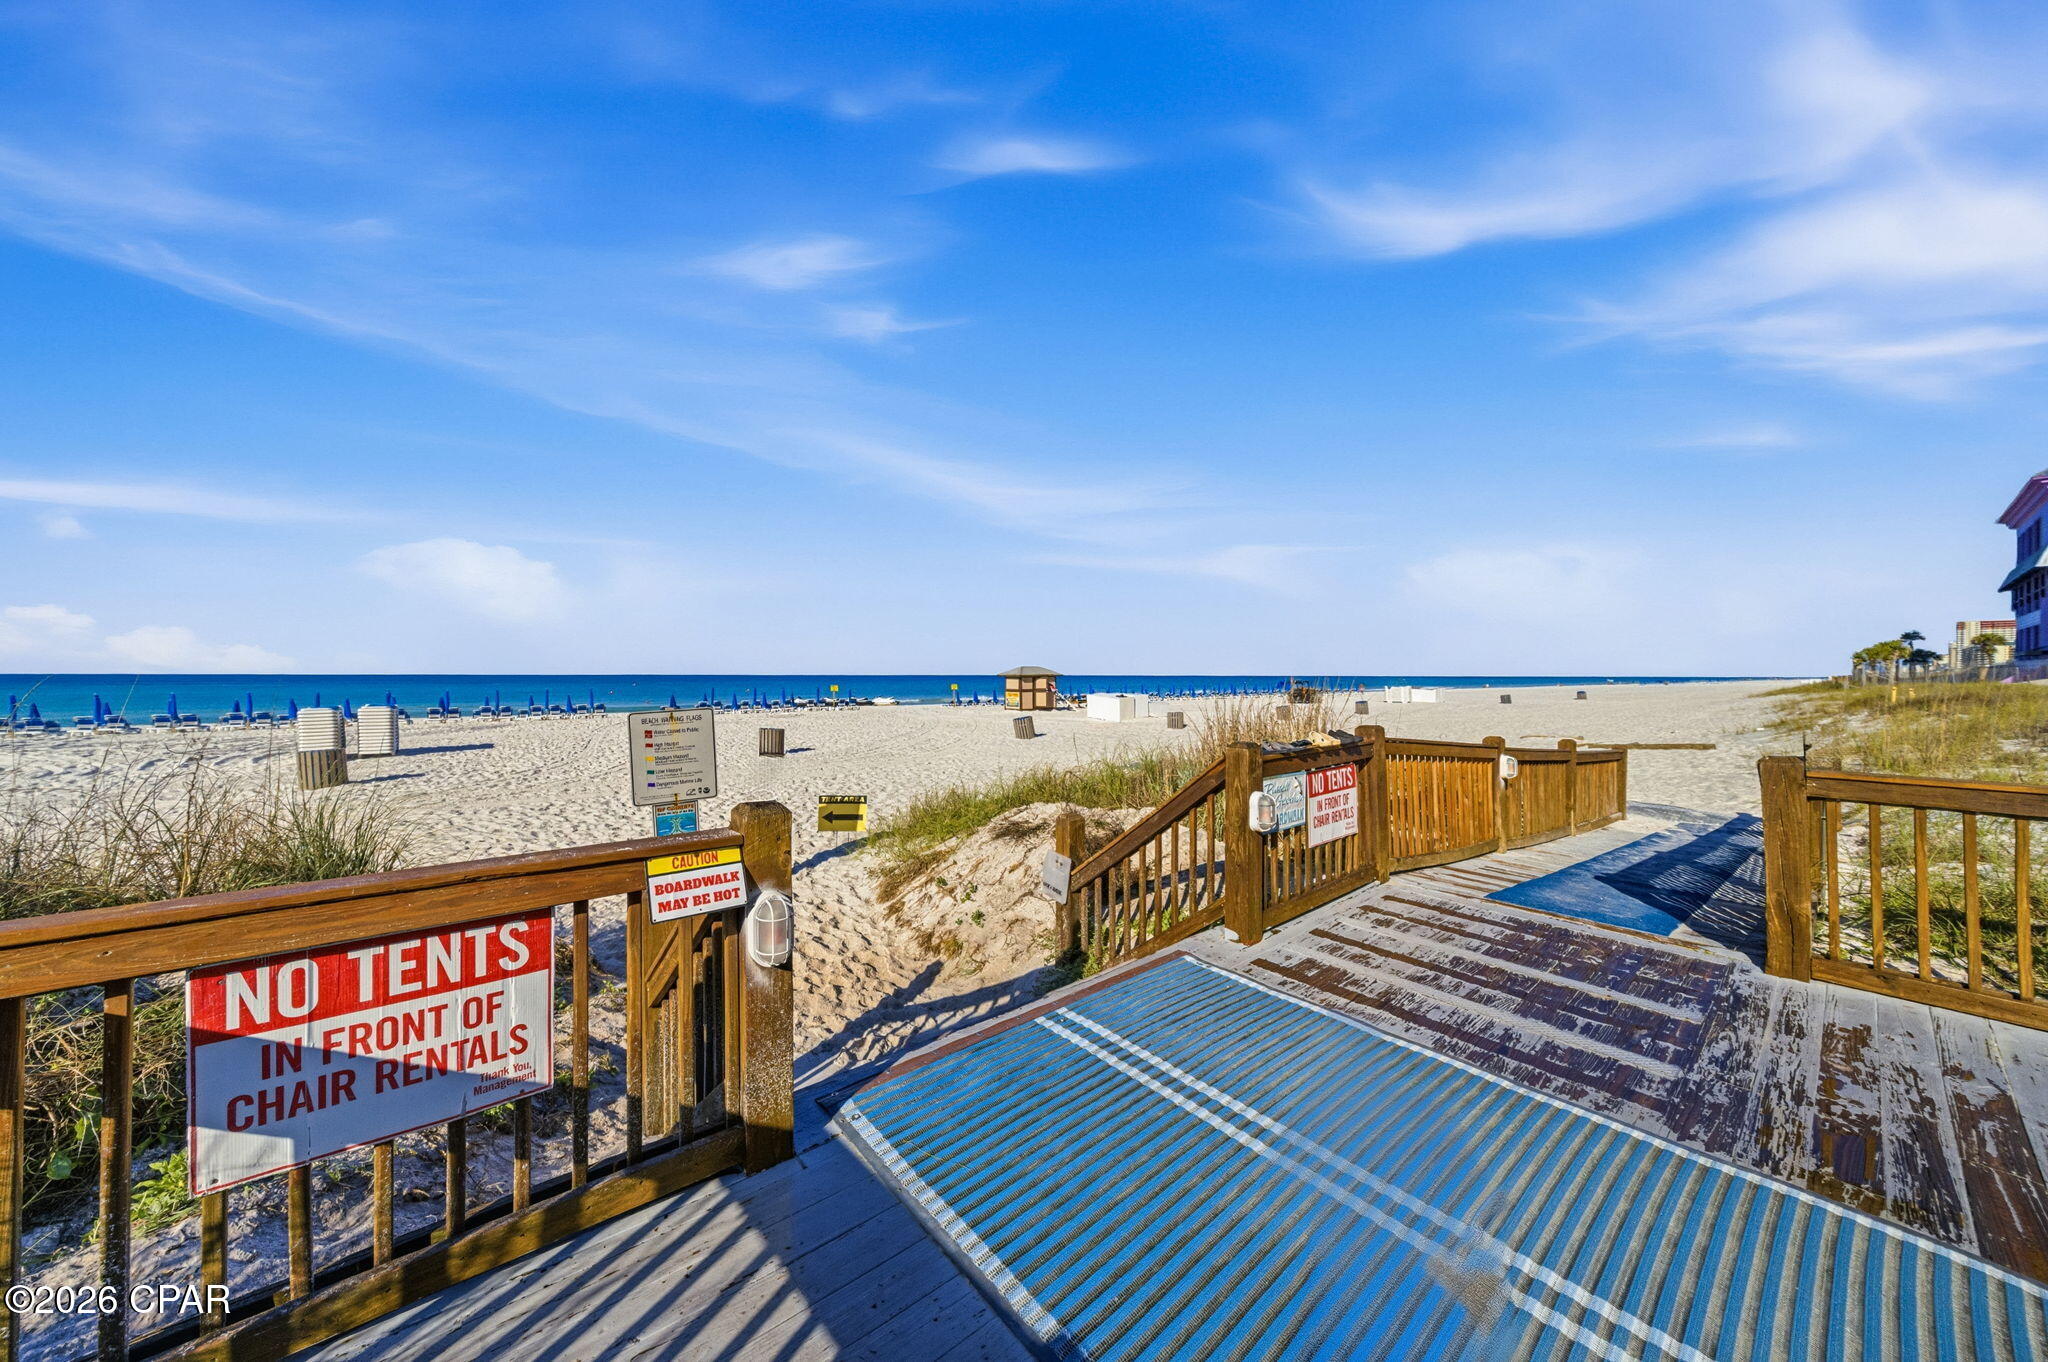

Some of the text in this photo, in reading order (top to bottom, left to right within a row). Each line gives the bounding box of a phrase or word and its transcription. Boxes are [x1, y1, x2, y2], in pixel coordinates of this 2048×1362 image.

[1312, 767, 1353, 794] NO TENTS
[1316, 799, 1323, 812] IN
[1324, 794, 1341, 810] FRONT
[1342, 793, 1350, 806] OF
[1313, 813, 1330, 829] CHAIR
[1331, 806, 1354, 823] RENTALS
[672, 851, 719, 869] CAUTION
[654, 871, 740, 896] BOARDWALK
[658, 887, 740, 913] MAY BE HOT
[225, 920, 531, 1031] NO TENTS
[261, 990, 505, 1080] IN FRONT OF
[226, 1023, 529, 1133] CHAIR RENTALS
[473, 1069, 536, 1096] Management
[480, 1067, 509, 1083] Thank
